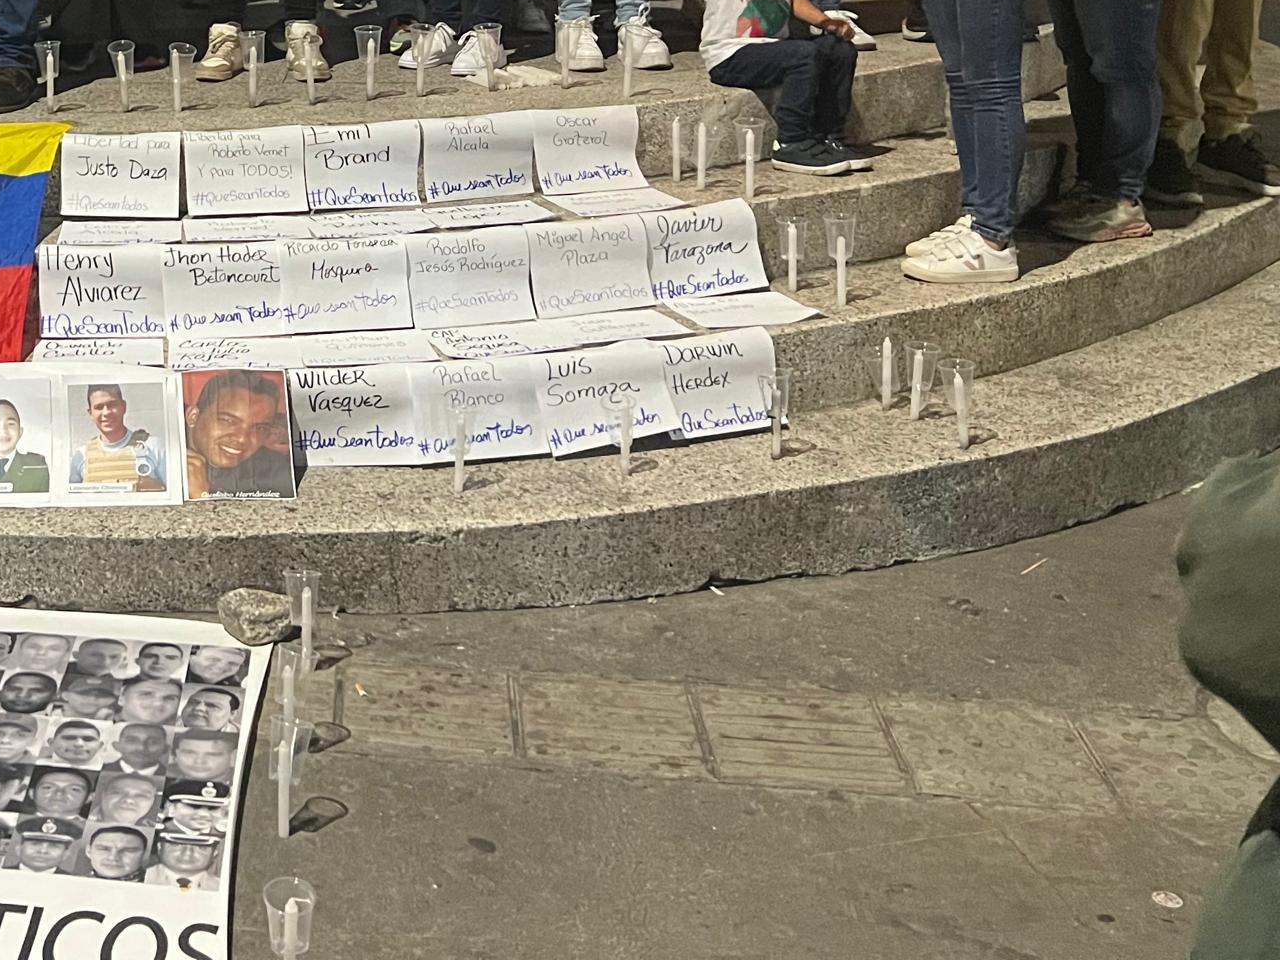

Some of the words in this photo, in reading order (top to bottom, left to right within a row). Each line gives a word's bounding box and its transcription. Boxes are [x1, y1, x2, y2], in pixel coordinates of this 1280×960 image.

[75, 155, 119, 178] Justo
[129, 158, 169, 181] Daza
[315, 145, 391, 172] Brand
[535, 225, 585, 250] Miguel
[656, 211, 724, 238] Javier
[162, 247, 213, 268] Jhon
[426, 238, 486, 256] Rodolfo
[560, 248, 610, 268] Plaza
[46, 246, 115, 278] Henry
[432, 360, 503, 386] Rafael
